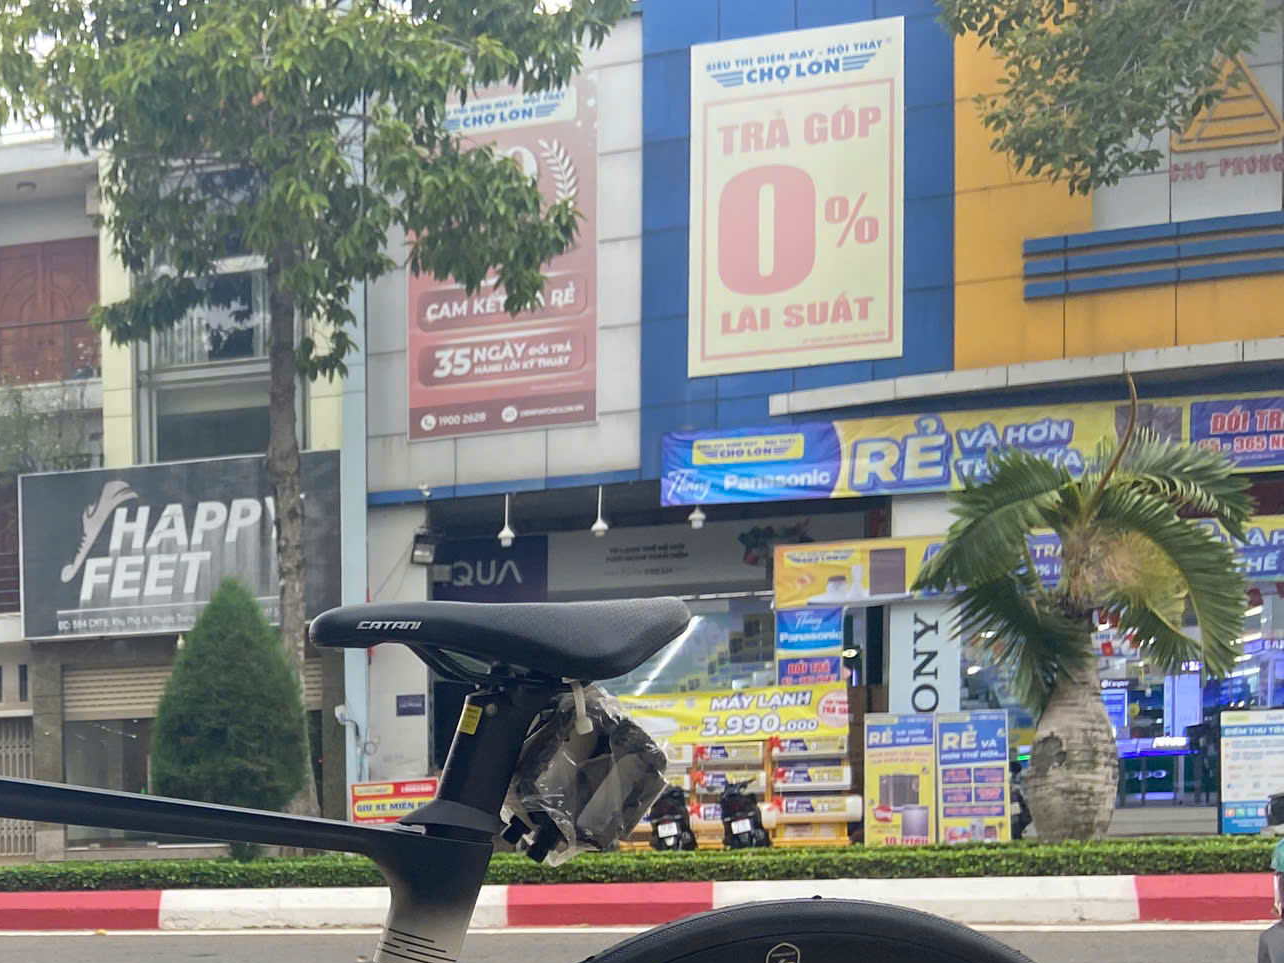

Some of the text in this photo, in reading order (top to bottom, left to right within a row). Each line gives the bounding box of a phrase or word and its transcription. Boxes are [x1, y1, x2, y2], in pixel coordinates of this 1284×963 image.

[803, 104, 881, 146] GÓP
[426, 300, 468, 322] CAM
[433, 347, 471, 378] 35
[473, 340, 527, 363] NGÀY
[1255, 408, 1284, 432] TR
[959, 423, 998, 449] VÀ
[852, 417, 950, 489] RẺ
[723, 468, 831, 491] Panasonic
[79, 551, 212, 602] FEET
[451, 559, 523, 587] QUA
[356, 620, 422, 631] CATANI
[911, 612, 939, 713] ONY
[710, 690, 812, 712] MÁY LẠNH
[942, 724, 978, 751] RẺ
